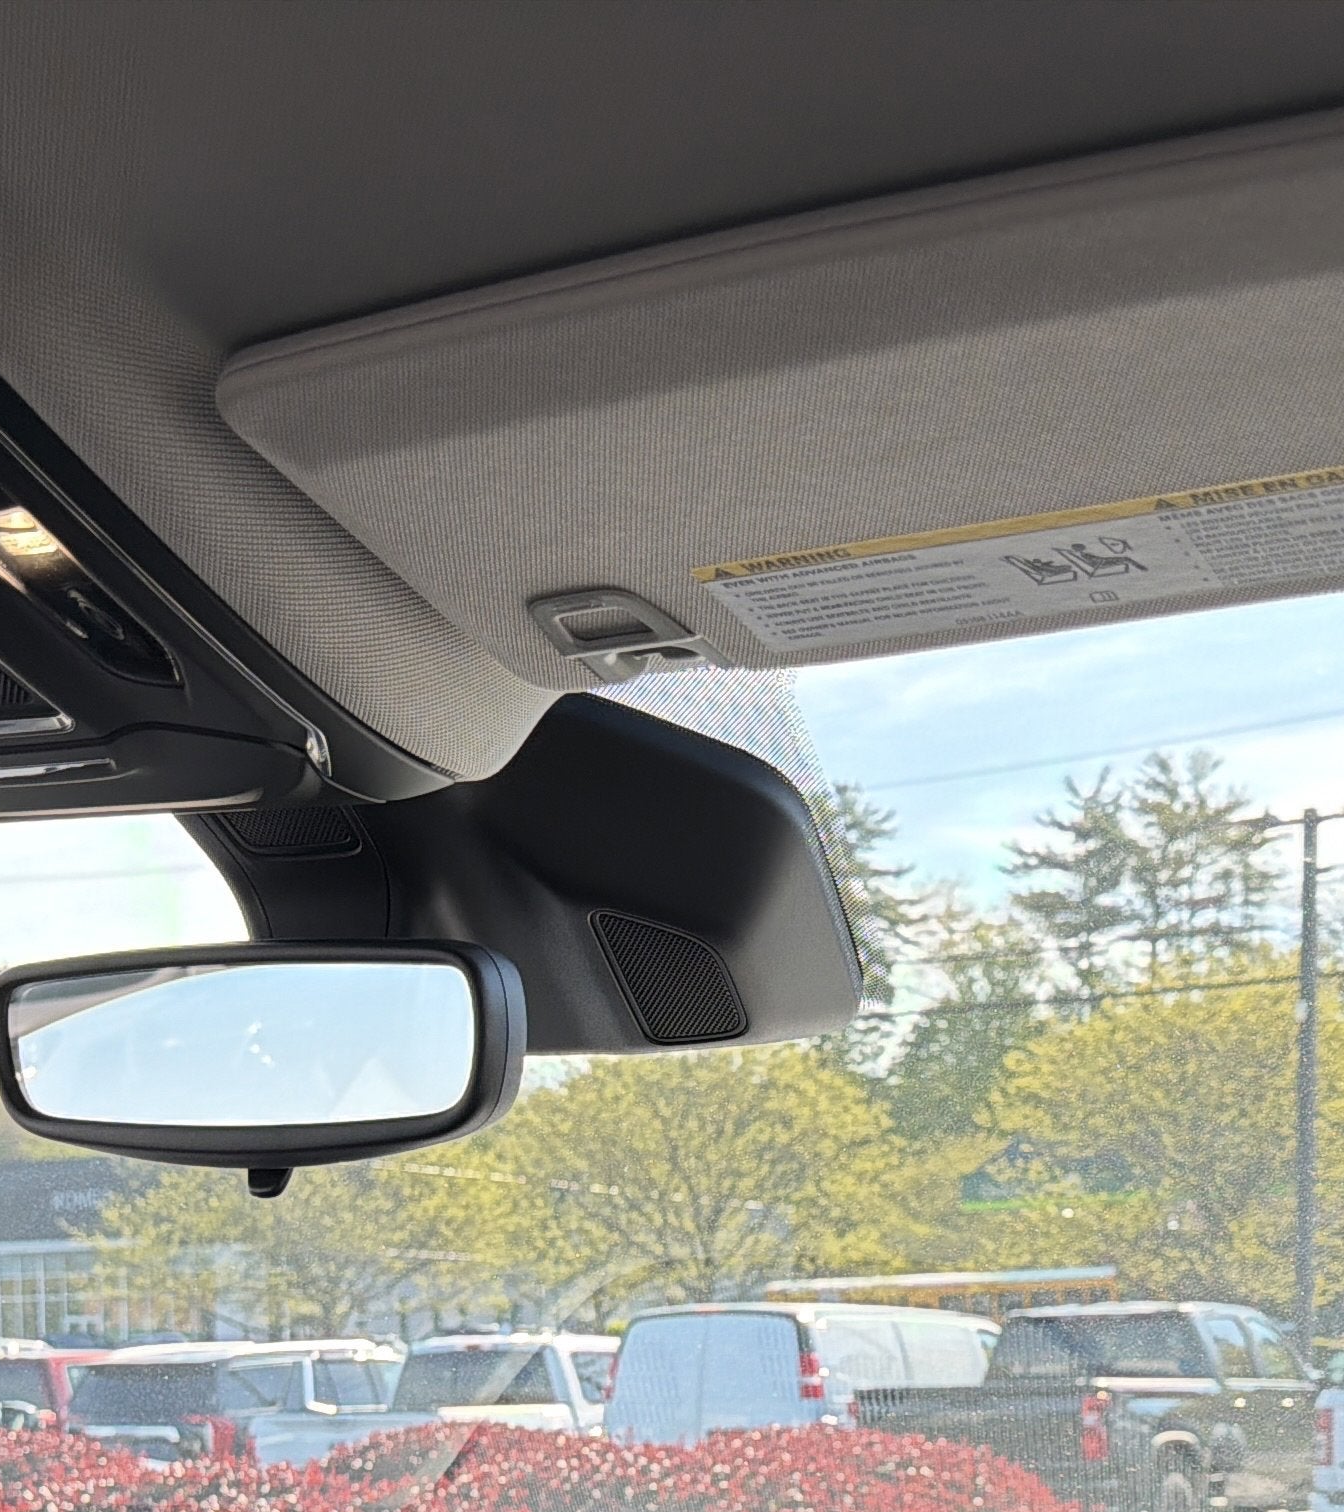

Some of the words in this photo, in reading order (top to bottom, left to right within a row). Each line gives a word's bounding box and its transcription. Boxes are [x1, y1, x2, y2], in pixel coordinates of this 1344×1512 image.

[1191, 483, 1257, 503] MISE
[1261, 477, 1297, 492] EN
[739, 548, 851, 575] WARNING
